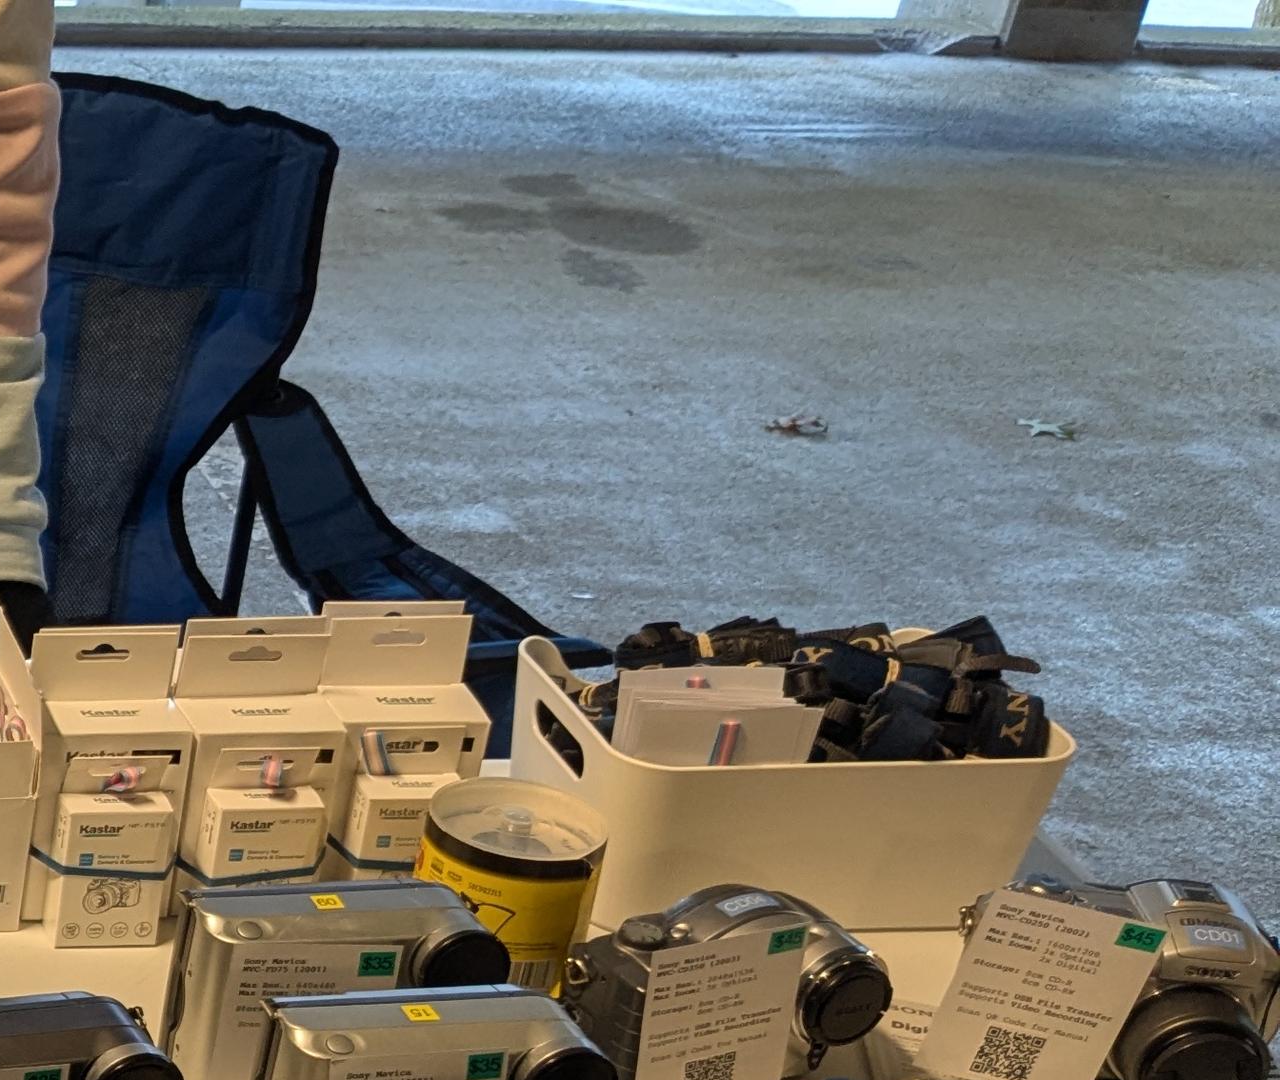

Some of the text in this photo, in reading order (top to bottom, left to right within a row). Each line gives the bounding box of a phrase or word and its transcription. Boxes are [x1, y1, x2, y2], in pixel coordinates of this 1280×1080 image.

[376, 696, 435, 705] Kastar
[80, 709, 140, 717] Kastar
[231, 707, 292, 716] Kastar
[385, 739, 423, 752] star
[379, 807, 424, 818] Kastar
[79, 824, 125, 834] Kastar
[230, 819, 275, 831] Kastar
[774, 929, 802, 950] $45
[1121, 926, 1156, 947] $45
[1194, 928, 1240, 944] CD01
[361, 954, 393, 973] $35
[470, 1056, 502, 1075] $35
